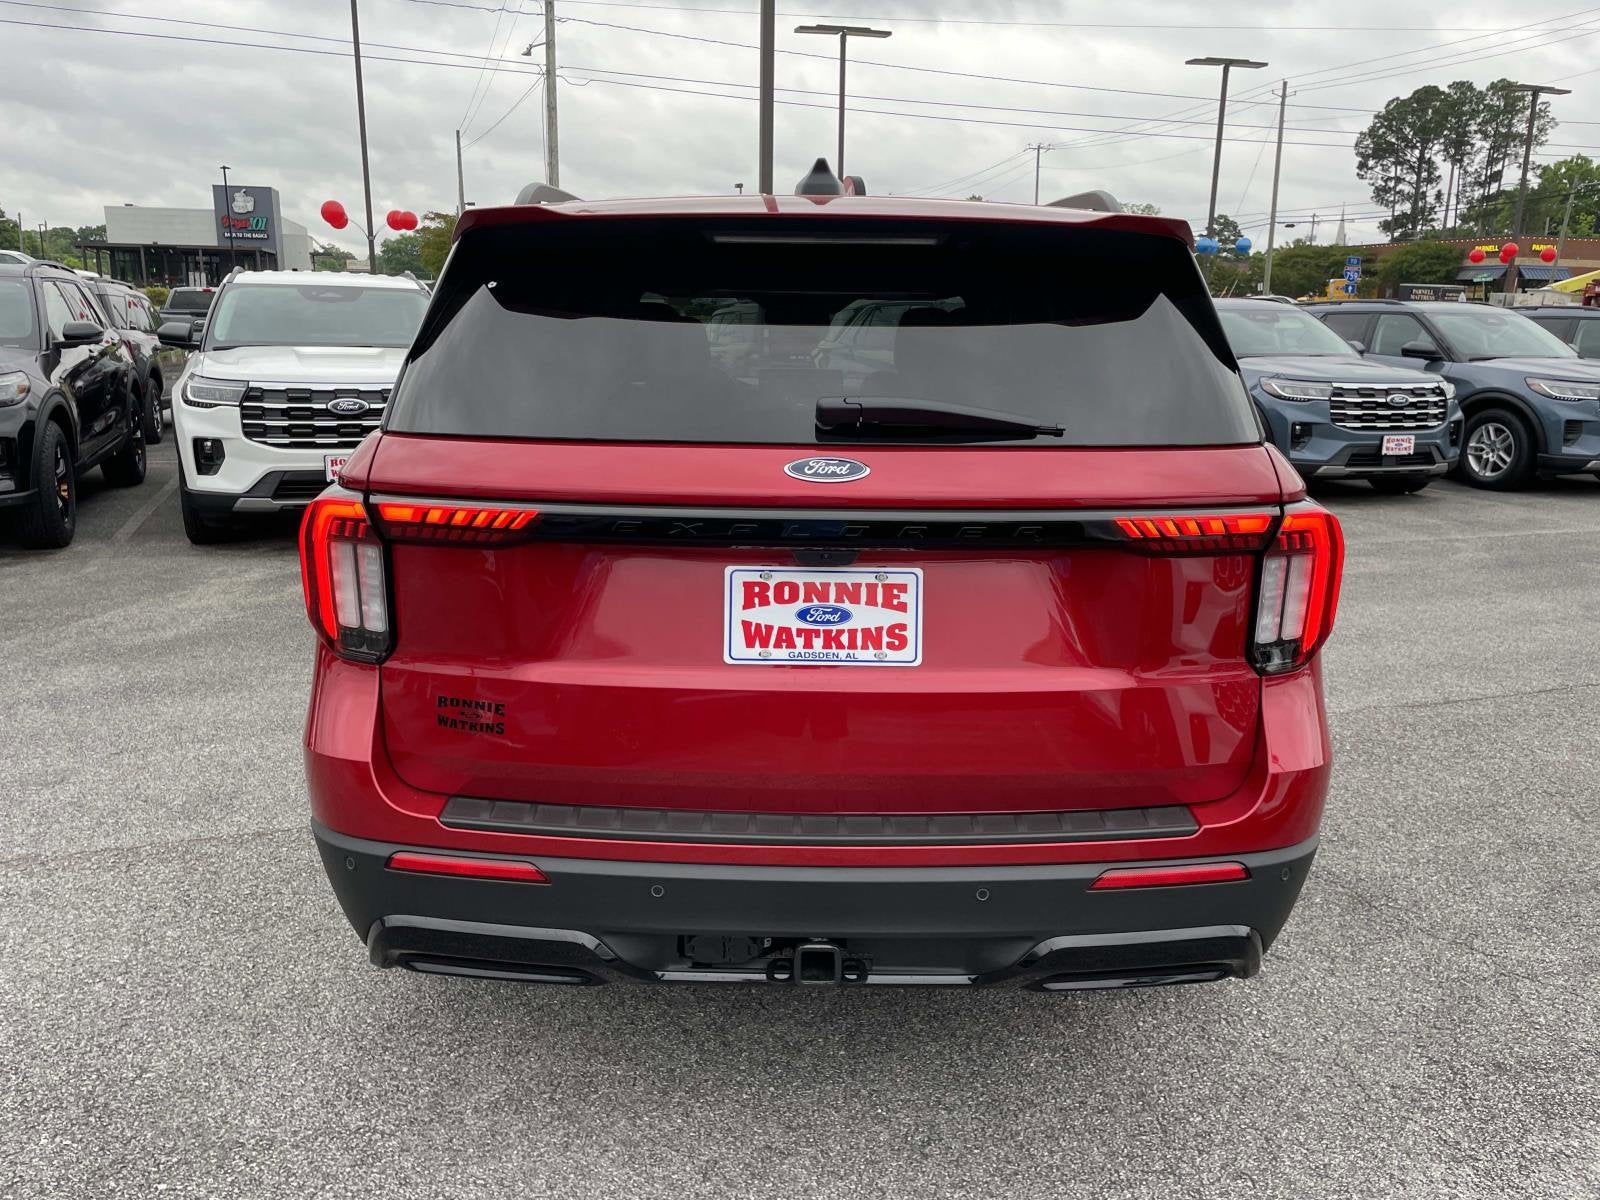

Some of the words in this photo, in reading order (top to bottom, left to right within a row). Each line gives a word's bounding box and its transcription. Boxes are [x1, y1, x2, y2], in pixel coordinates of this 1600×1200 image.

[1346, 271, 1358, 281] 759
[337, 401, 360, 411] Ford
[804, 459, 851, 475] Ford
[611, 520, 1043, 542] EXPLORER
[742, 581, 908, 614] RONNIE
[806, 608, 841, 623] Ford
[741, 619, 909, 652] WATKINS
[788, 651, 842, 661] GADSDEN,
[845, 652, 859, 660] AL
[437, 695, 505, 717] RONNIE
[437, 714, 505, 735] WATKINS
